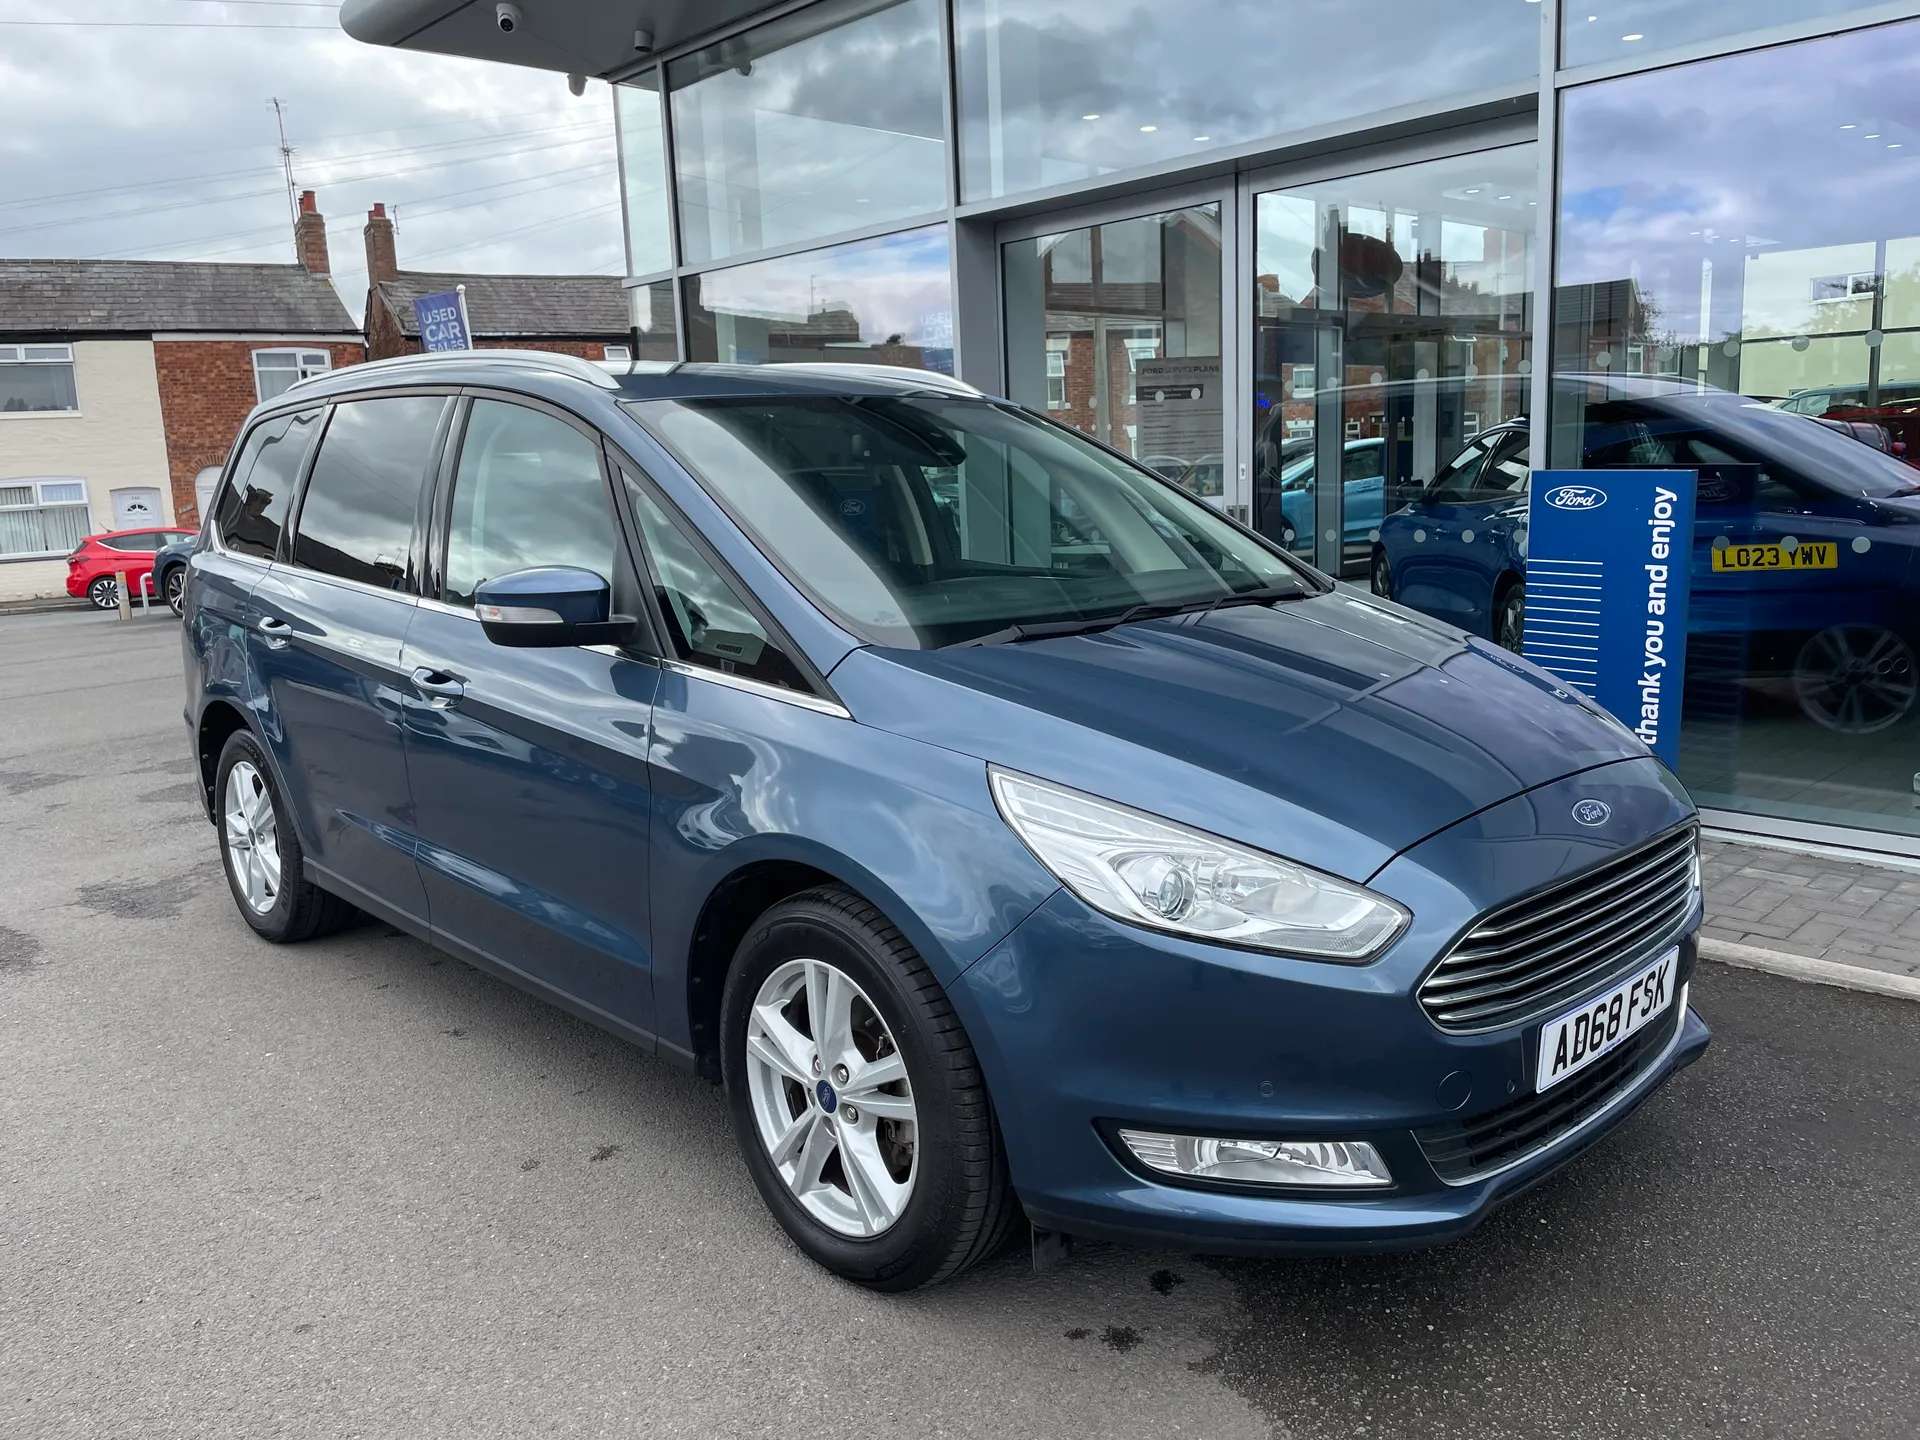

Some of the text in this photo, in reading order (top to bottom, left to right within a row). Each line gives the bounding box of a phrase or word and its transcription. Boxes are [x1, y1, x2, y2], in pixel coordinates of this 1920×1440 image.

[422, 307, 456, 323] USED
[426, 322, 461, 341] CAR
[1555, 488, 1596, 506] Ford
[1787, 545, 1827, 566] YWV
[1633, 486, 1678, 745] thank you and enjoy
[1551, 959, 1671, 1077] AD68 FSK
